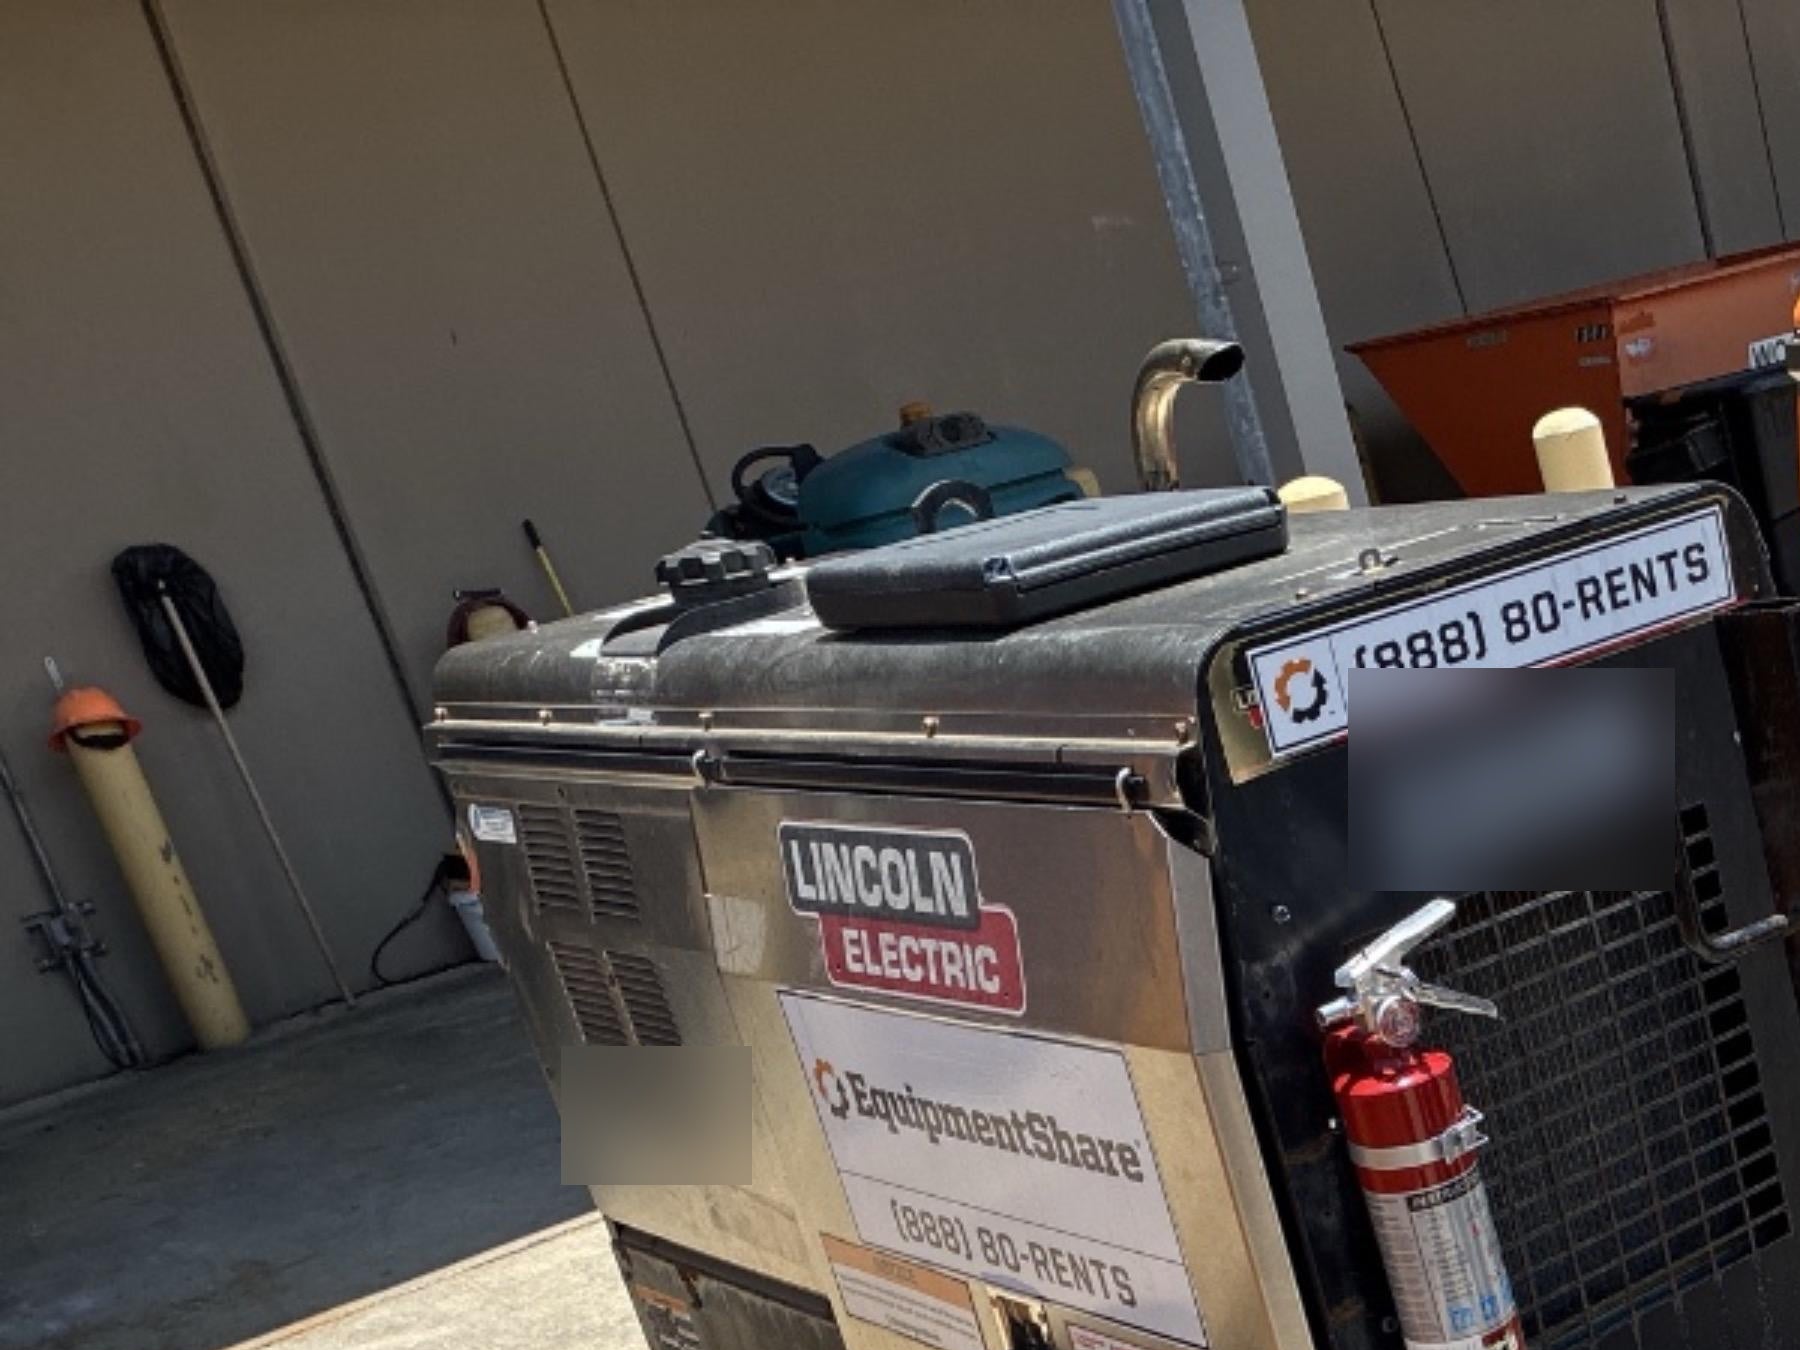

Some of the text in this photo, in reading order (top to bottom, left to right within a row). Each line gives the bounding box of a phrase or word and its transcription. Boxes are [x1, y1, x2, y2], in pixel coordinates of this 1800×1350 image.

[1500, 541, 1711, 644] 80-RENTS
[790, 839, 970, 917] LINCOLN
[842, 928, 1000, 995] ELECTRIC
[846, 1070, 1144, 1183] EquipmentShare
[889, 1198, 973, 1261] (888)
[976, 1226, 1138, 1308] 80-RENTS
